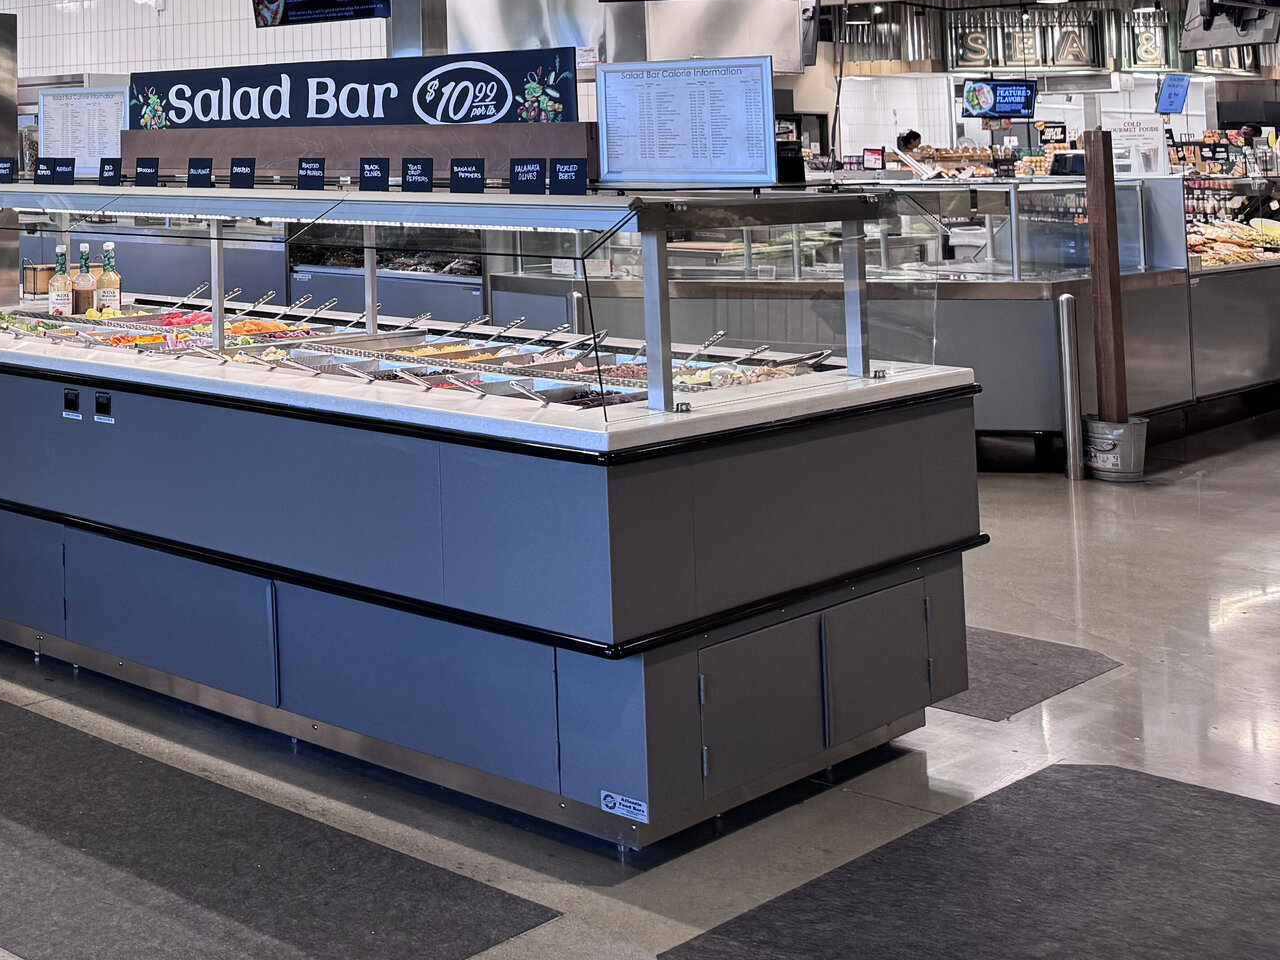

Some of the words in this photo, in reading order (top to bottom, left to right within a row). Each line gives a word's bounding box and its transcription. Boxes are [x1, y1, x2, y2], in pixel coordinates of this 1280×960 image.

[964, 32, 1088, 61] SEA
[1137, 32, 1161, 62] &
[621, 71, 644, 80] Salad
[646, 71, 660, 79] Bar
[661, 69, 692, 79] Calorie
[693, 68, 742, 77] Information
[168, 73, 291, 124] Salad
[306, 77, 399, 120] Bar
[470, 106, 486, 119] per
[515, 164, 540, 173] KALAMATA
[556, 164, 579, 172] PICKLED
[518, 172, 537, 180] OLIVES
[558, 172, 576, 180] BEETS
[621, 797, 642, 807] Atlantic
